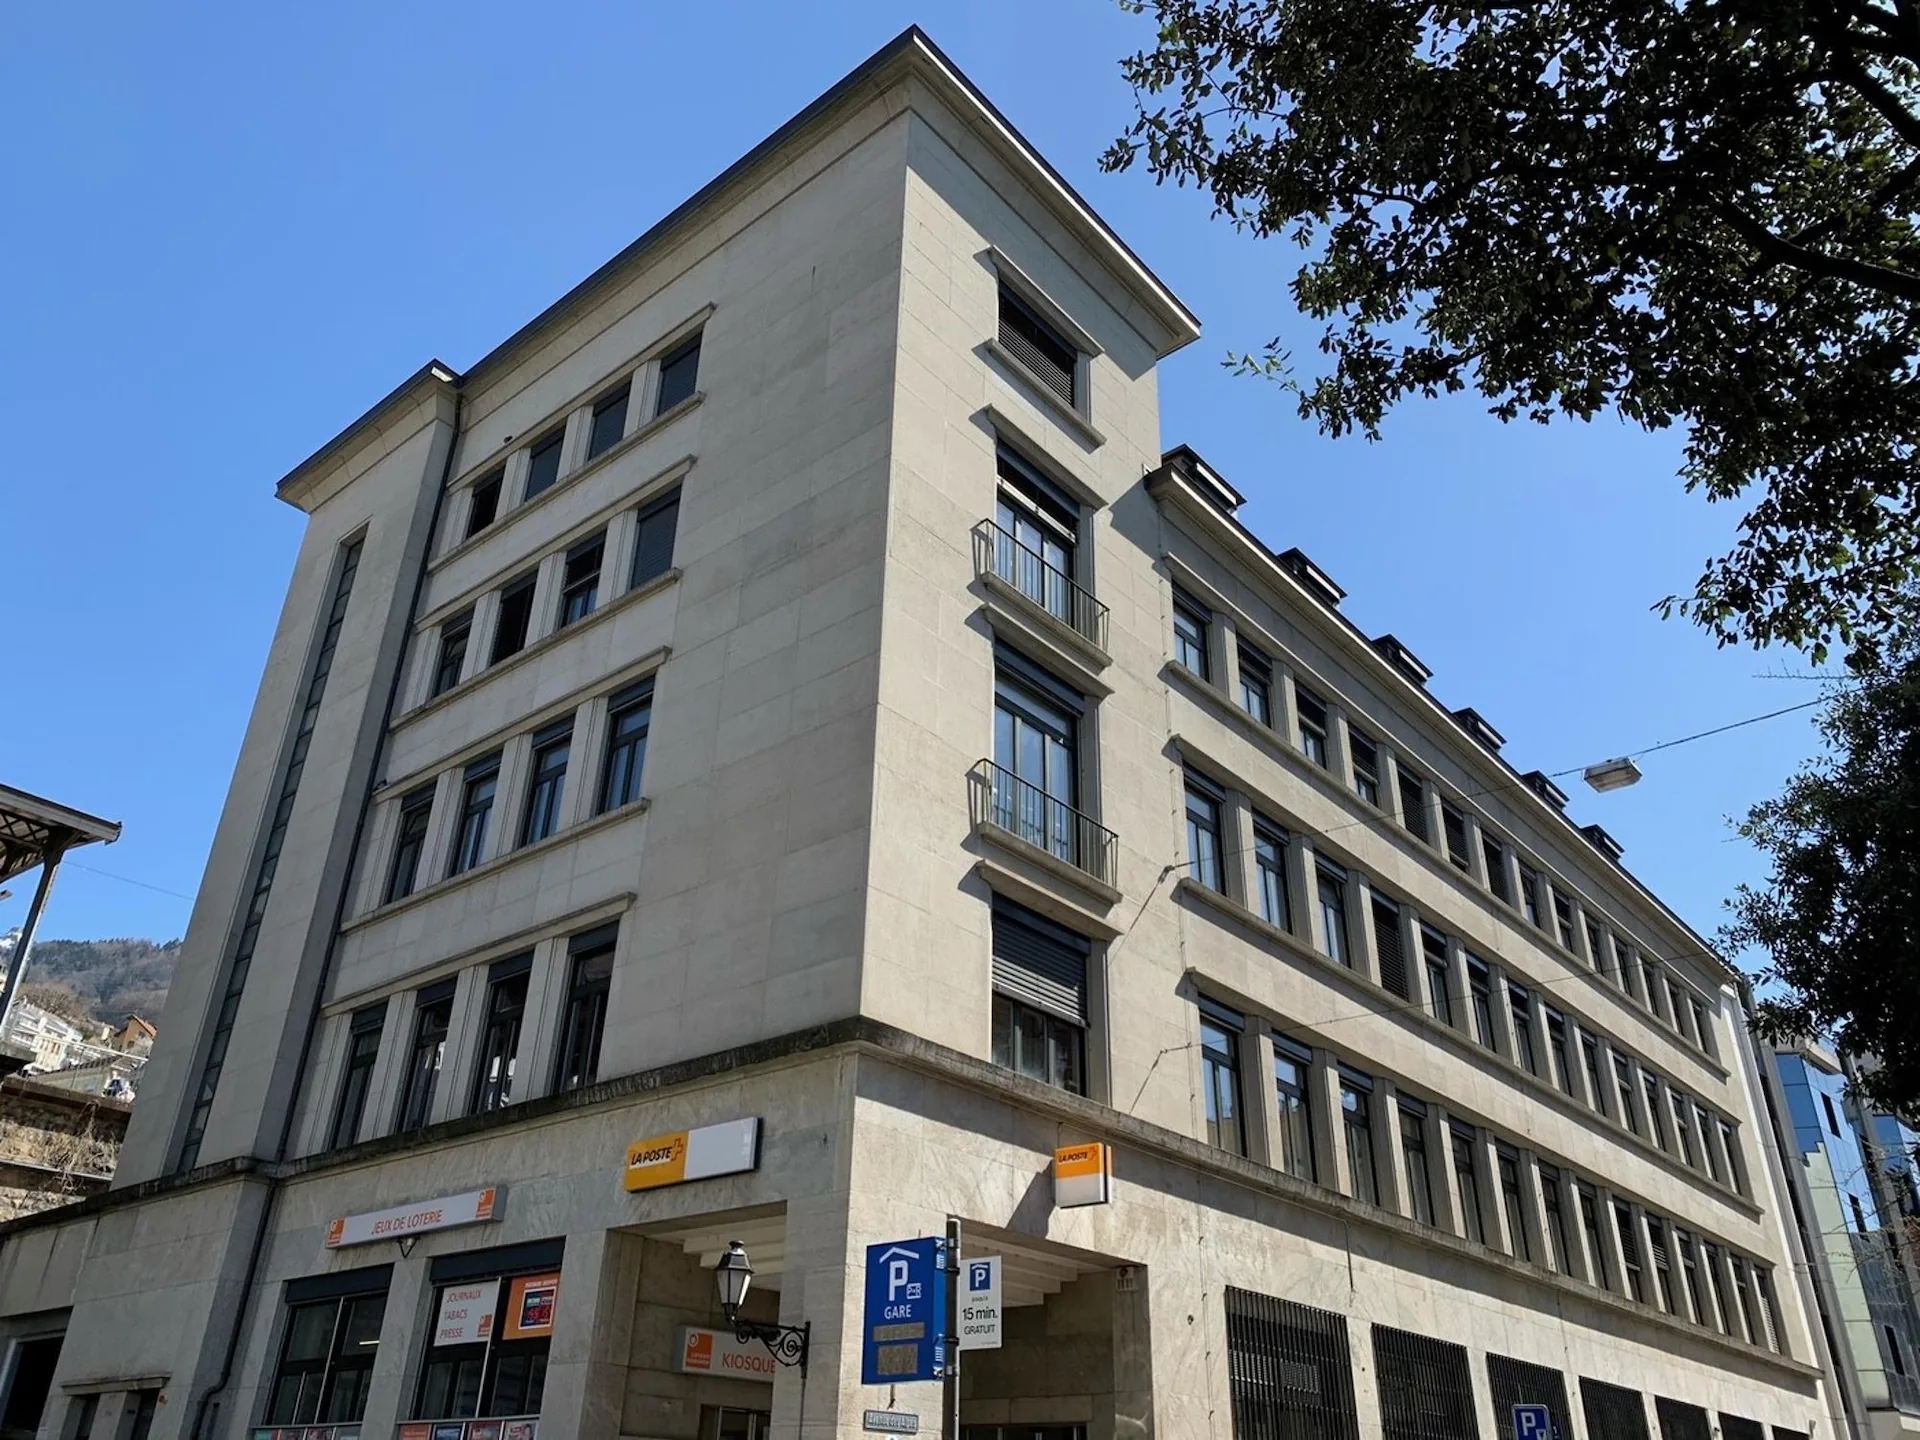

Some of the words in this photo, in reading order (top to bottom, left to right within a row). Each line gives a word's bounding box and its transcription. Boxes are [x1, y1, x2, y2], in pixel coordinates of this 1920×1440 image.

[631, 1152, 641, 1165] LA
[643, 1147, 672, 1164] POSTE
[1067, 1151, 1088, 1161] POSTE
[371, 1222, 391, 1235] JEUX
[393, 1217, 406, 1231] DE
[407, 1210, 443, 1228] LOTERIE
[889, 1260, 909, 1301] P
[446, 1289, 482, 1303] JOURNAUX
[444, 1309, 469, 1320] TABACS
[884, 1304, 912, 1320] GARE
[962, 1307, 974, 1320] 15
[976, 1306, 998, 1320] min.
[440, 1327, 464, 1339] PRESSE
[964, 1324, 996, 1335] GRATUIT
[722, 1352, 776, 1374] KIOSQUE
[1520, 1412, 1536, 1436] P
